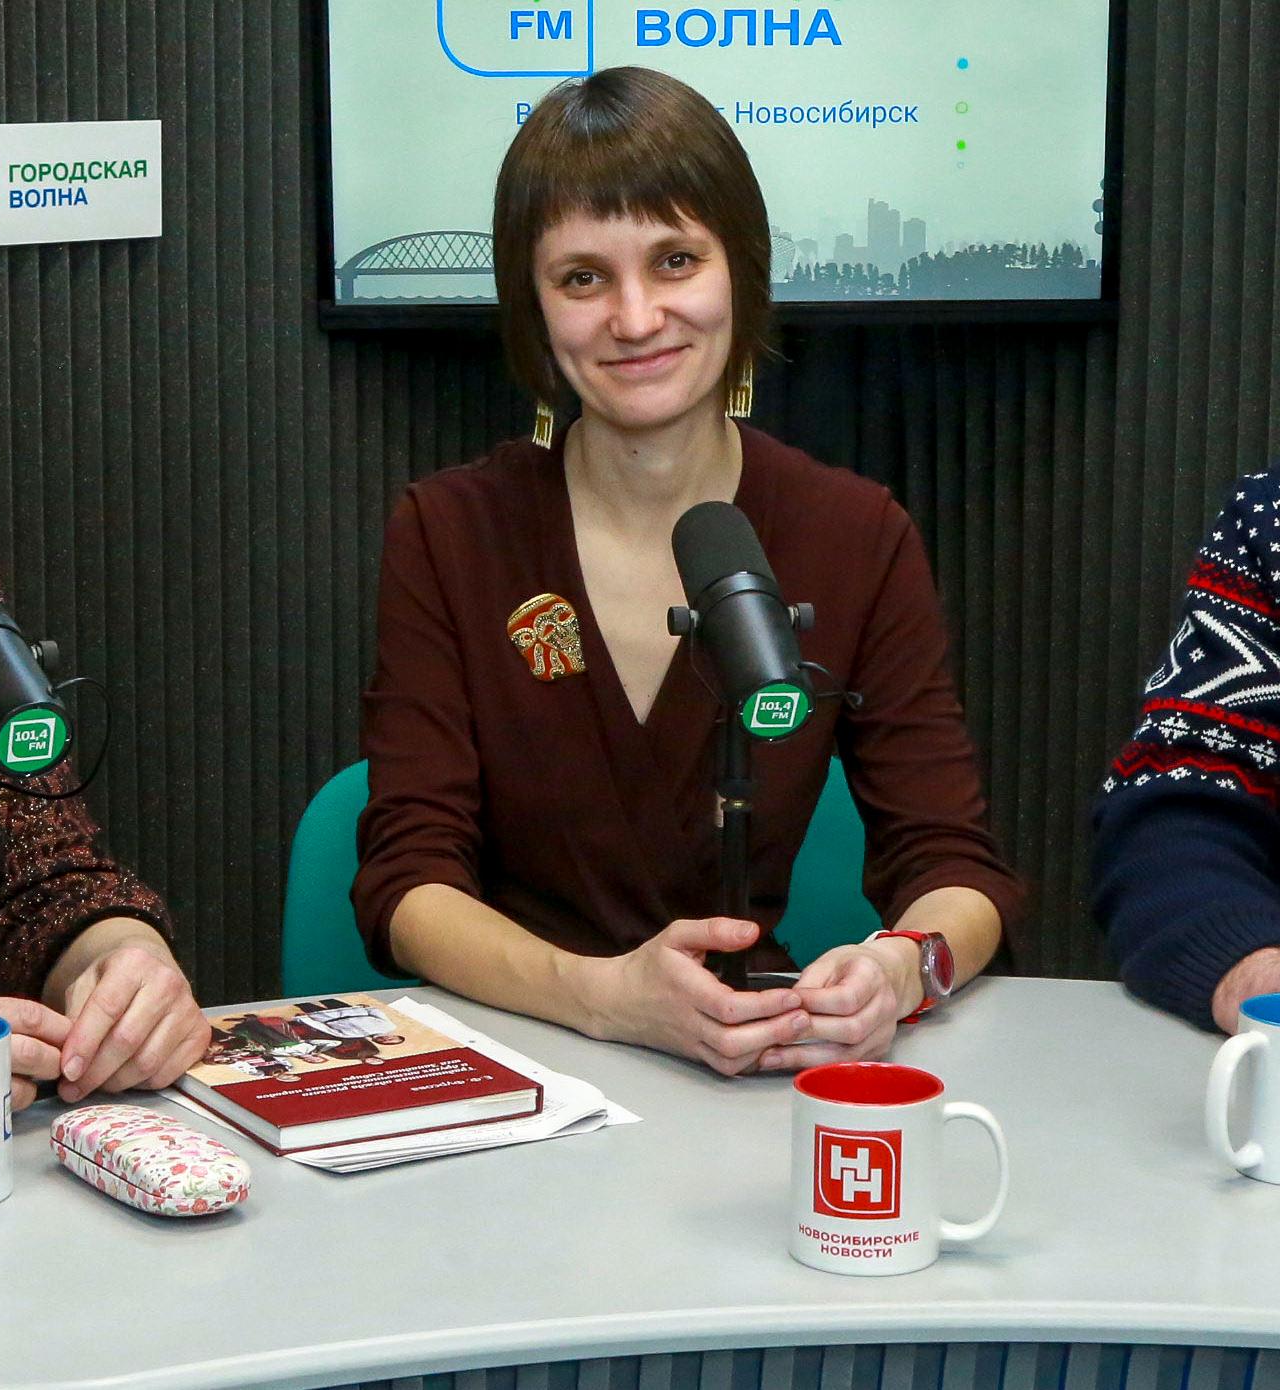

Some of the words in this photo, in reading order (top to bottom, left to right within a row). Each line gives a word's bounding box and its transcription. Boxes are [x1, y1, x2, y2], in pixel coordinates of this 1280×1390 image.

[510, 10, 572, 40] FM
[636, 9, 842, 47] ВОЛНА
[735, 100, 918, 129] Новосибирск
[8, 159, 148, 183] ГОРОДСКАЯ
[9, 187, 88, 209] ВОЛНА
[760, 701, 792, 711] 101,4
[14, 729, 49, 741] 101,4
[28, 741, 47, 751] FM
[798, 1223, 920, 1246] НОВОСИБИРСКИЕ
[820, 1244, 893, 1258] НОВОСТИ
